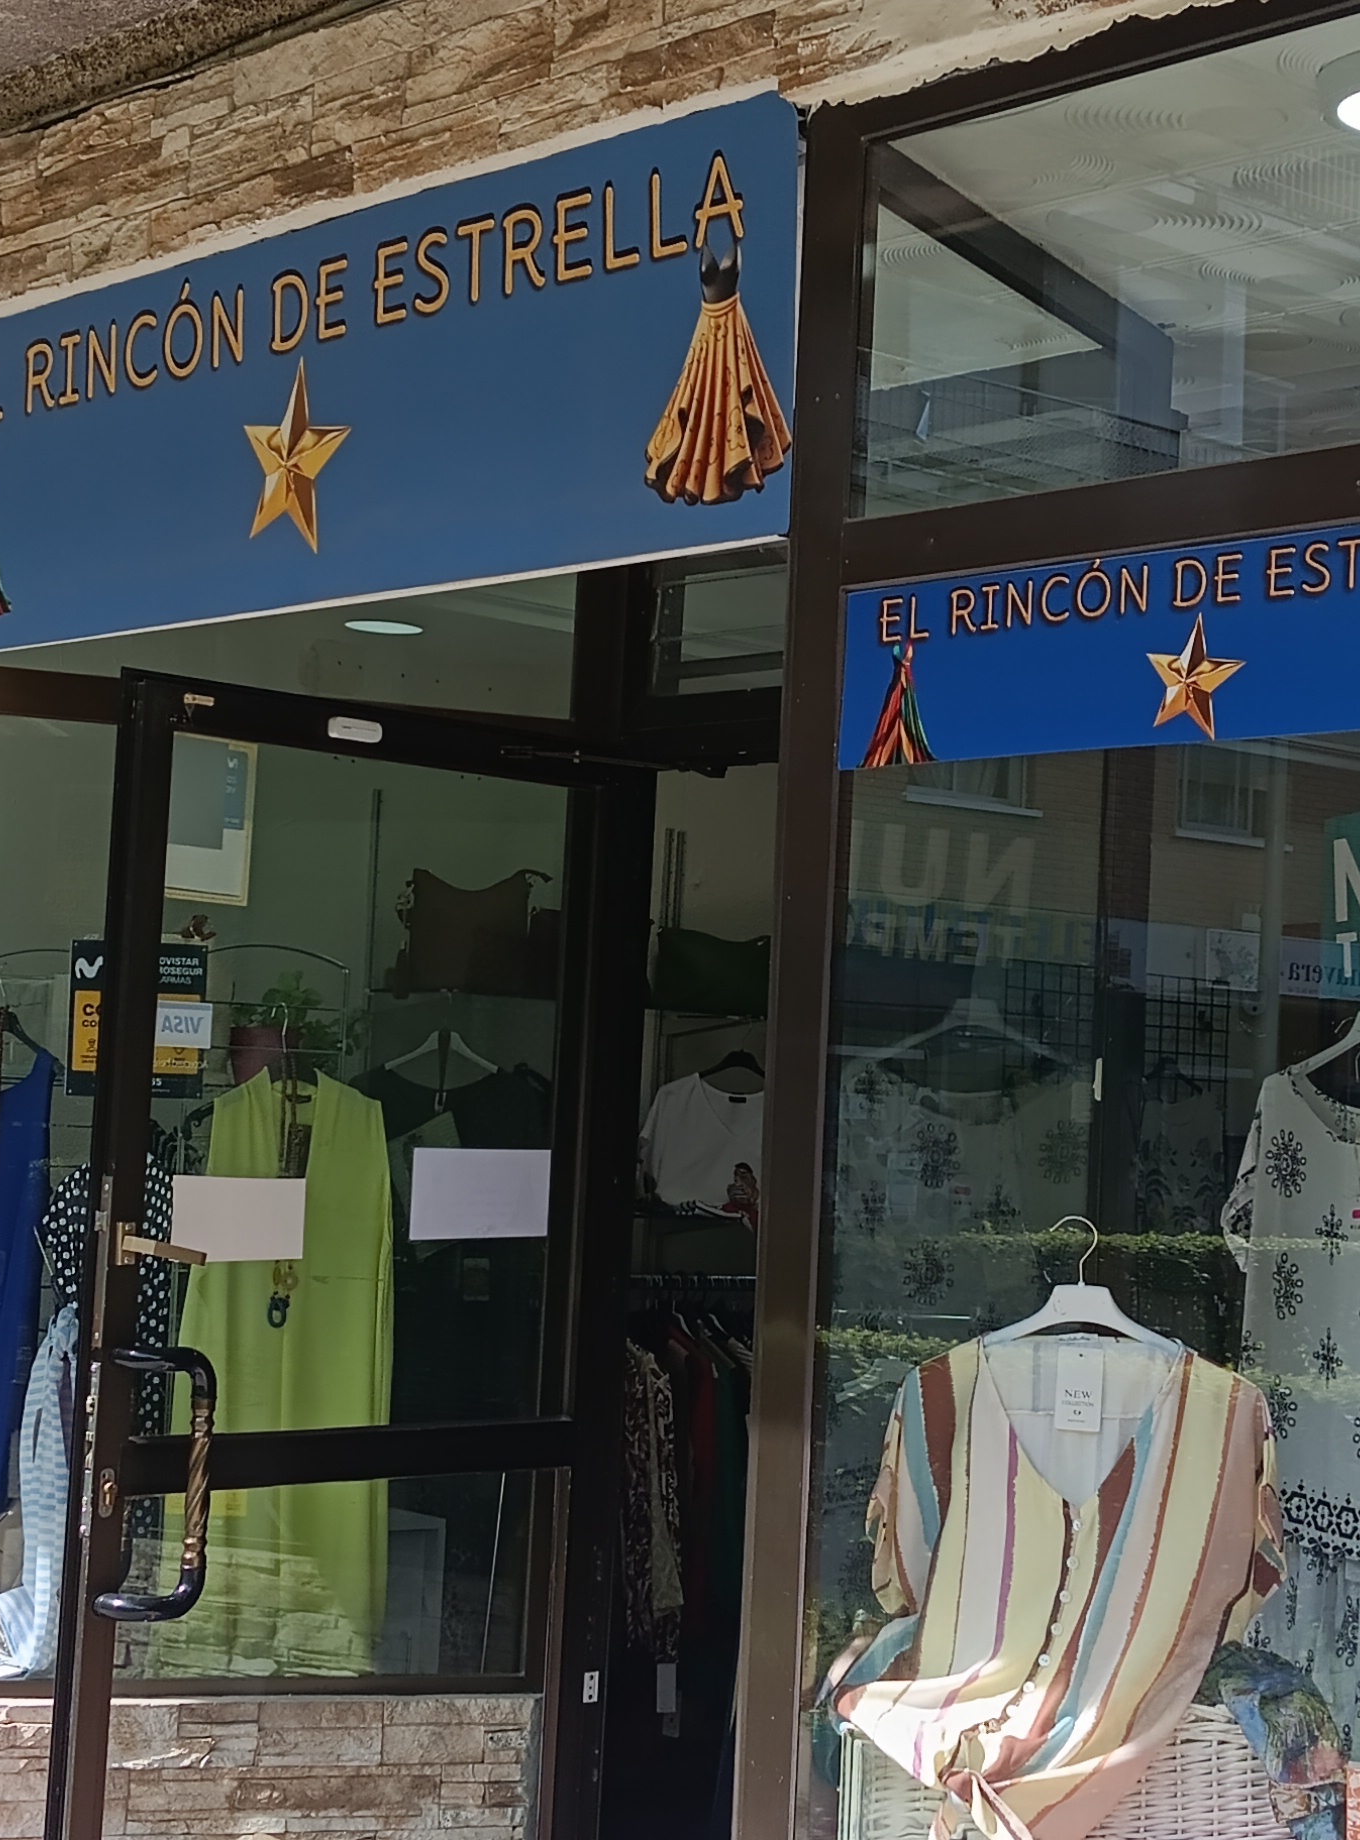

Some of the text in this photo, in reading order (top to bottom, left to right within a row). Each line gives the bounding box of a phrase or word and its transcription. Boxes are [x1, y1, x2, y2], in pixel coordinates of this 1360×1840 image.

[25, 277, 246, 415] RINCÓN
[270, 255, 349, 356] DE
[373, 150, 746, 328] ESTRELLA
[878, 595, 929, 645] EL
[949, 558, 1149, 635] RINCÓN
[1172, 553, 1243, 610] DE
[159, 956, 200, 967] OVISTAR
[159, 966, 203, 976] OSEGUR
[159, 975, 192, 985] ARMAS
[1064, 1389, 1092, 1400] NEW
